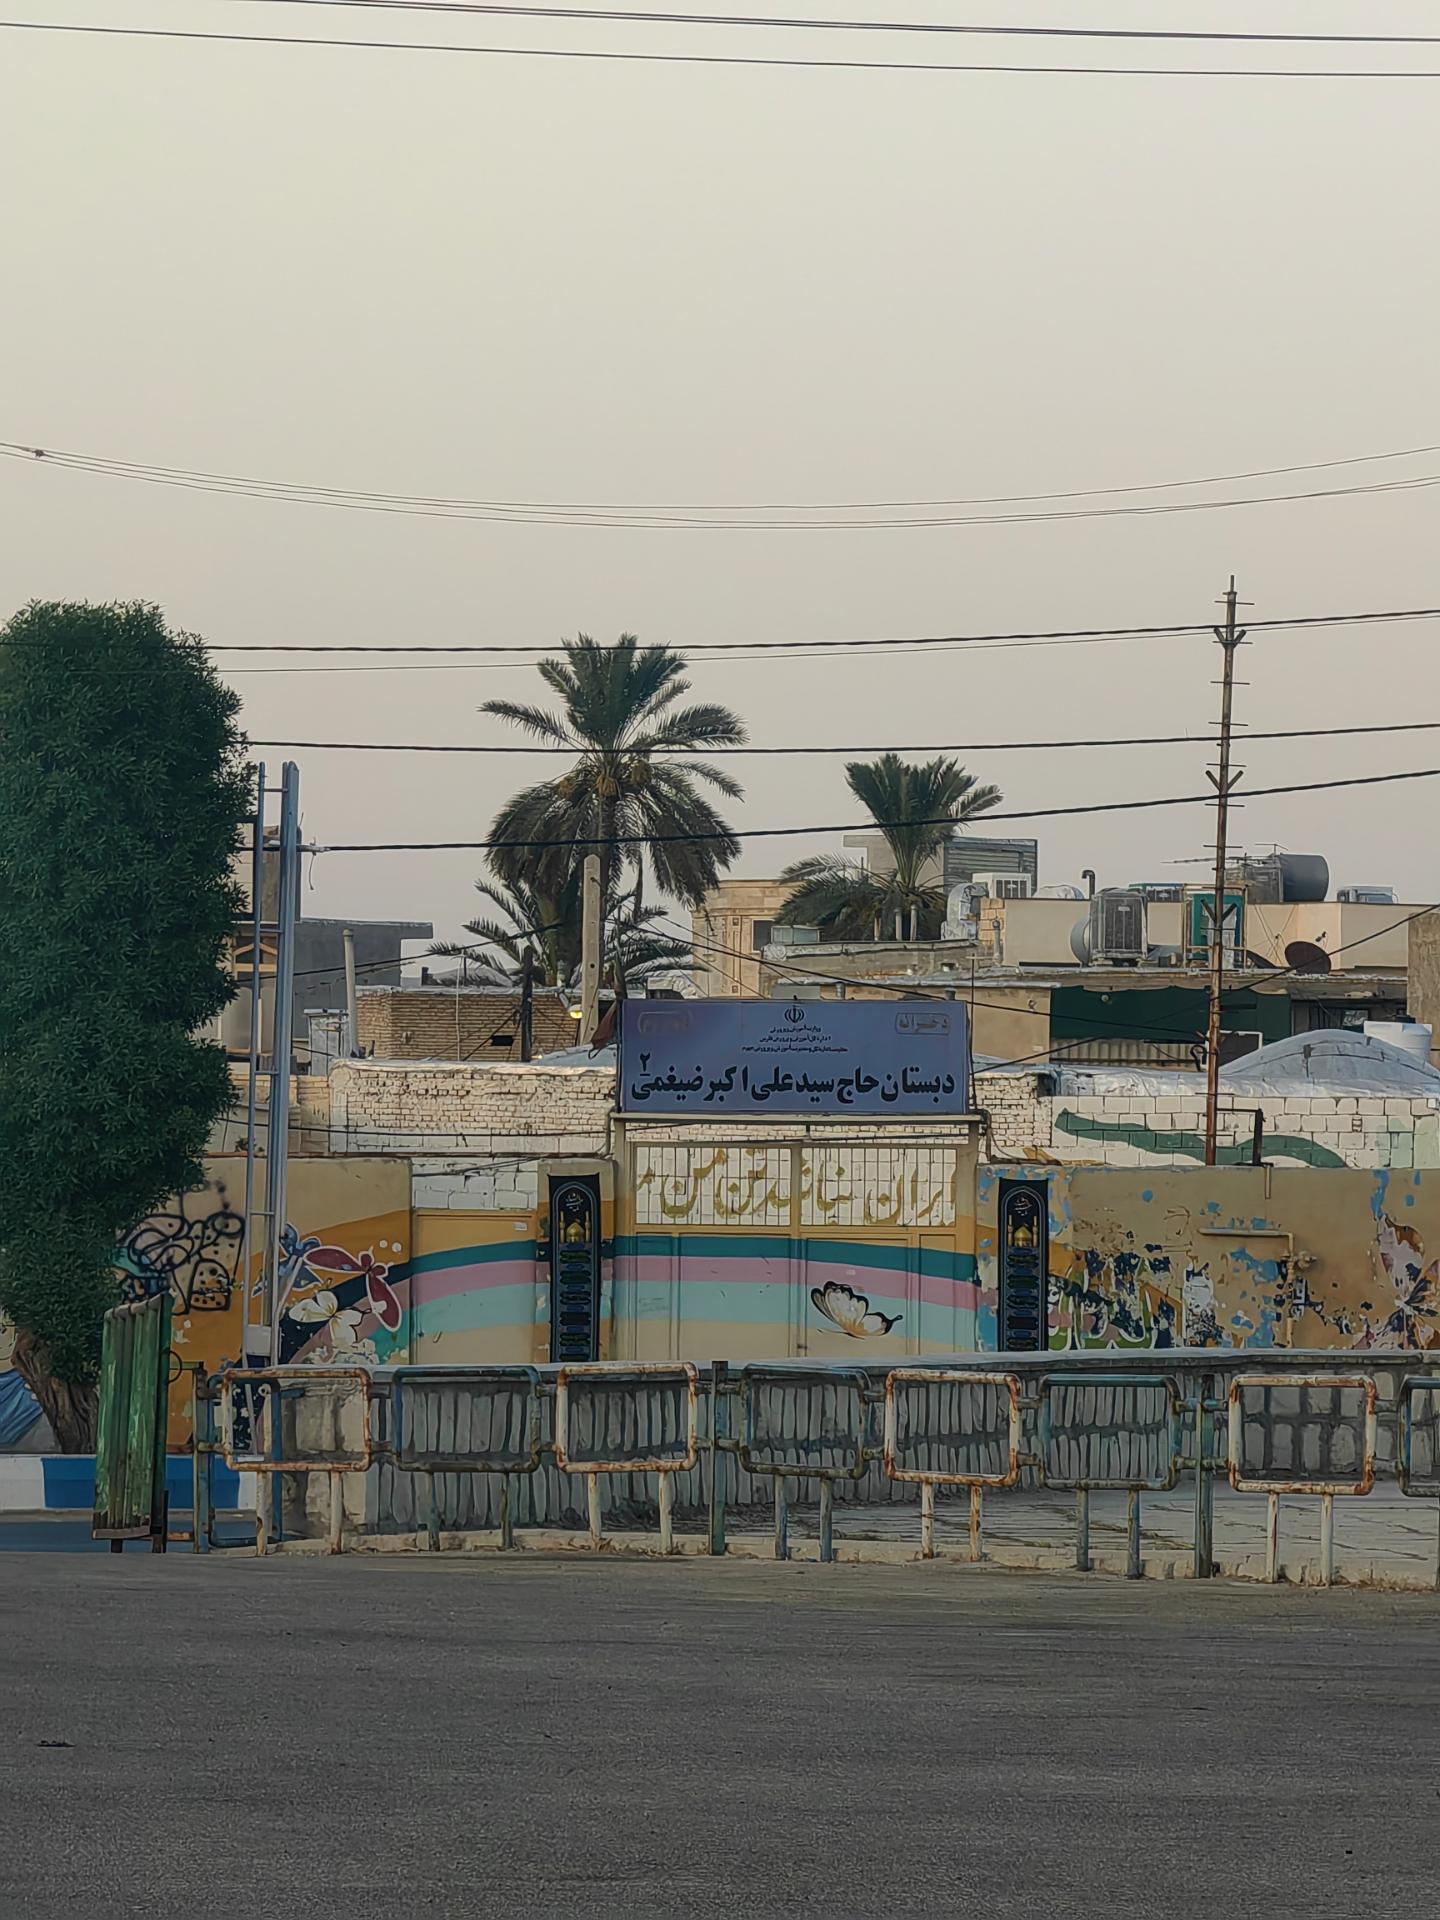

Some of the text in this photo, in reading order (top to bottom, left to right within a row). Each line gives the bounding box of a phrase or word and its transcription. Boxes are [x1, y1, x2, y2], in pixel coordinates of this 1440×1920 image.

[631, 1066, 704, 1102] ضیغمی
[703, 1066, 748, 1102] اکبر
[751, 1066, 794, 1101] علی
[796, 1075, 834, 1104] سید
[836, 1066, 879, 1104] حاج
[881, 1066, 956, 1104] دبستان
